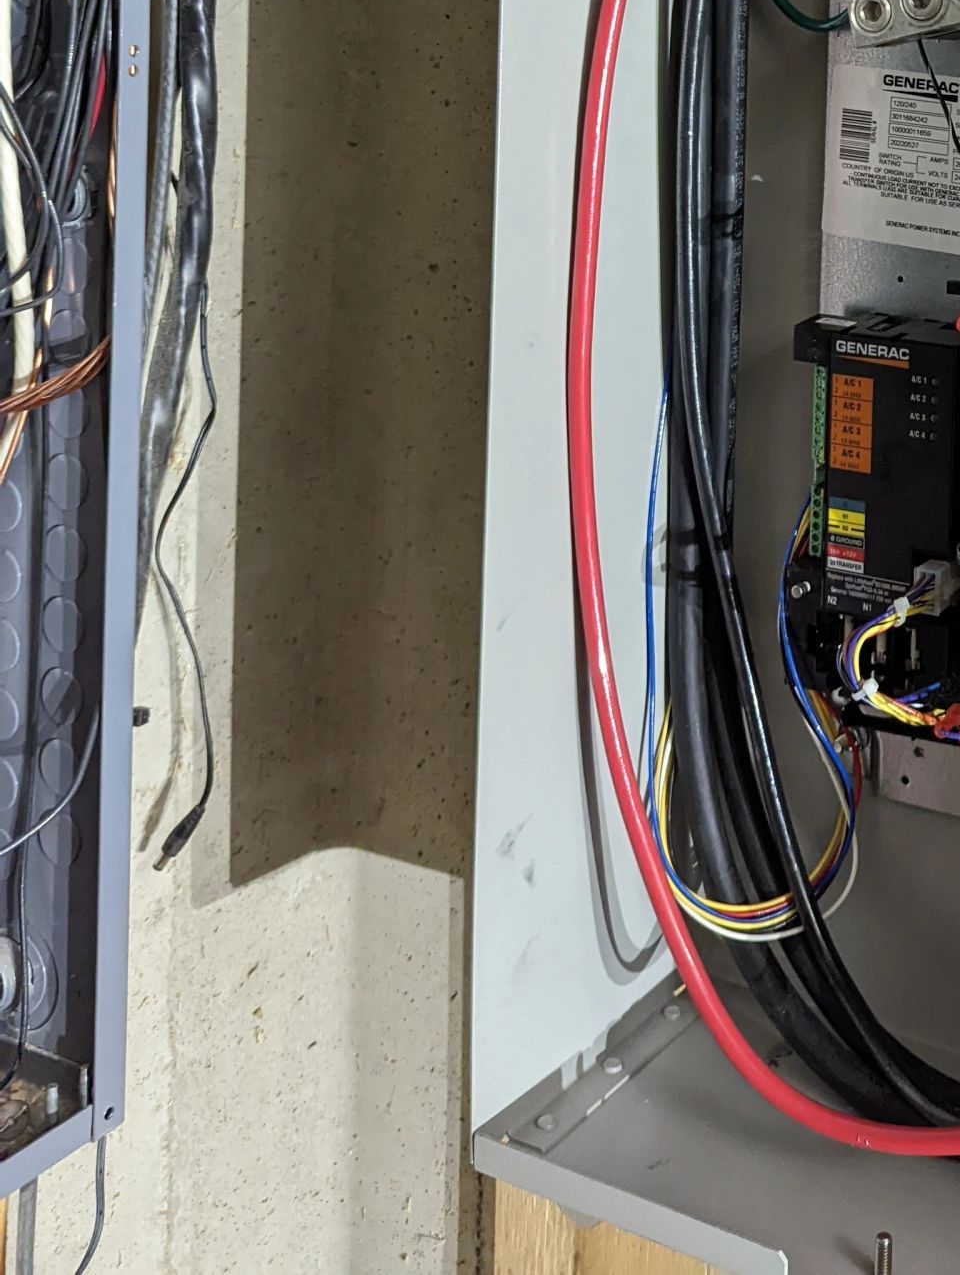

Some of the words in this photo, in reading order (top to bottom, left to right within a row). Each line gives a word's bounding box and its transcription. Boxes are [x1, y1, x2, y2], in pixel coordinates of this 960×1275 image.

[882, 73, 959, 94] GENERAC
[878, 152, 901, 160] SWITCH
[929, 156, 948, 164] AMPS
[841, 162, 871, 171] COUNTRY
[883, 168, 904, 176] ORIGIN
[878, 158, 900, 167] RATING
[928, 170, 948, 178] VOLTS
[880, 191, 908, 200] SUITABLE
[925, 197, 937, 205] USE
[885, 220, 908, 229] GENERAC
[909, 223, 928, 232] POWER
[928, 227, 951, 235] SYSTEMS
[835, 339, 909, 360] GENERAC
[844, 377, 855, 387] A/C
[911, 375, 921, 383] A/C
[910, 393, 920, 401] A/C
[909, 412, 920, 420] A/C
[856, 427, 860, 435] 3
[909, 429, 919, 437] A/C
[835, 536, 862, 546] GROUND
[836, 560, 861, 570] TRANSFER
[827, 595, 837, 605] N2
[862, 602, 871, 612] N1
